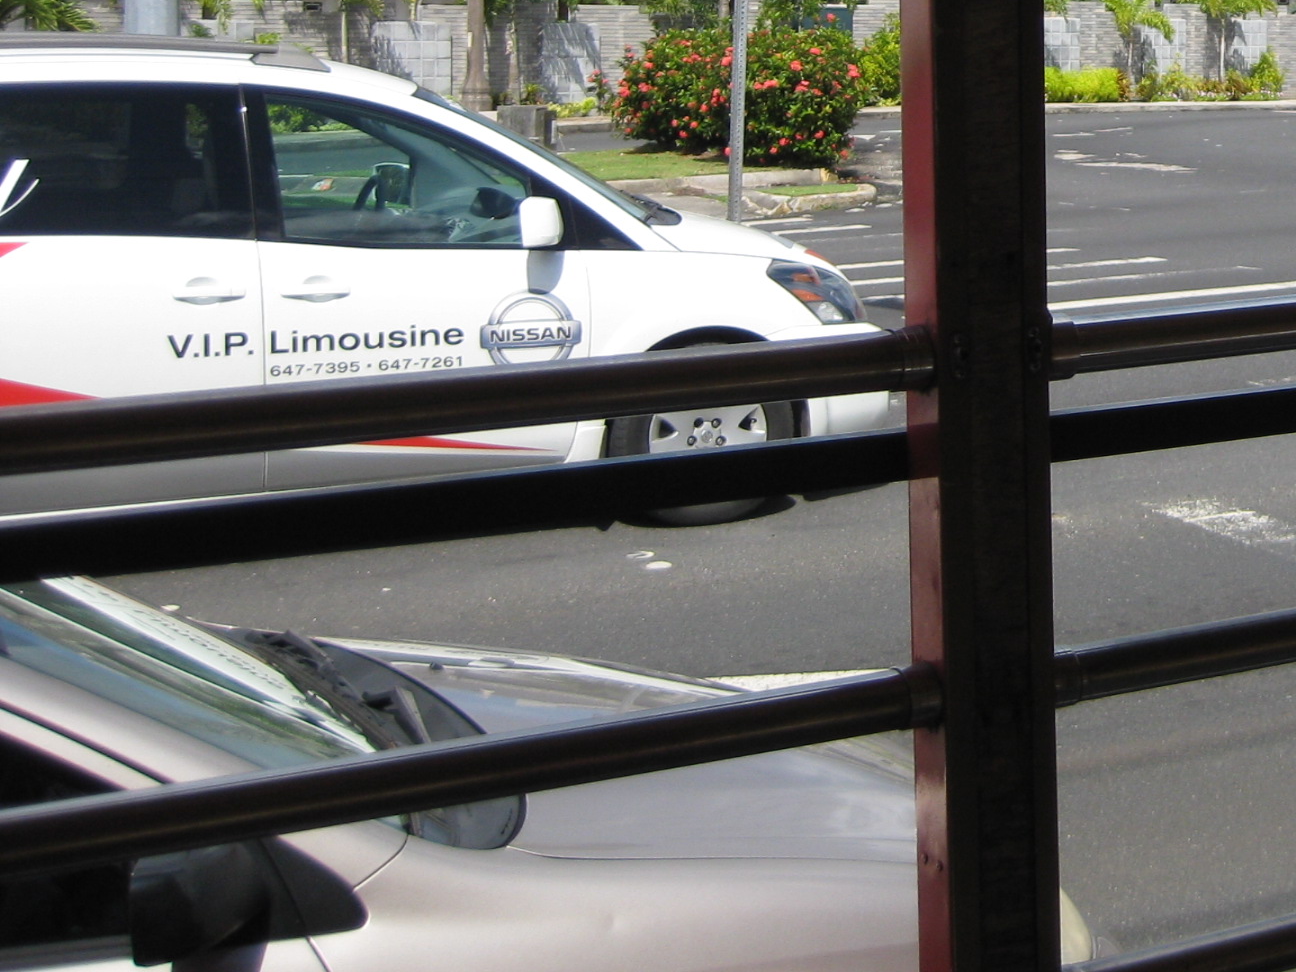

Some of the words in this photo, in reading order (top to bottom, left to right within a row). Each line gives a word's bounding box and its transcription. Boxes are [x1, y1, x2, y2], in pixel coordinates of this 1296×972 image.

[167, 331, 254, 359] V.I.P.
[269, 324, 465, 354] Limousine
[489, 326, 571, 344] NISSAN
[270, 361, 360, 377] 647-7395
[379, 356, 464, 372] 647-7261
